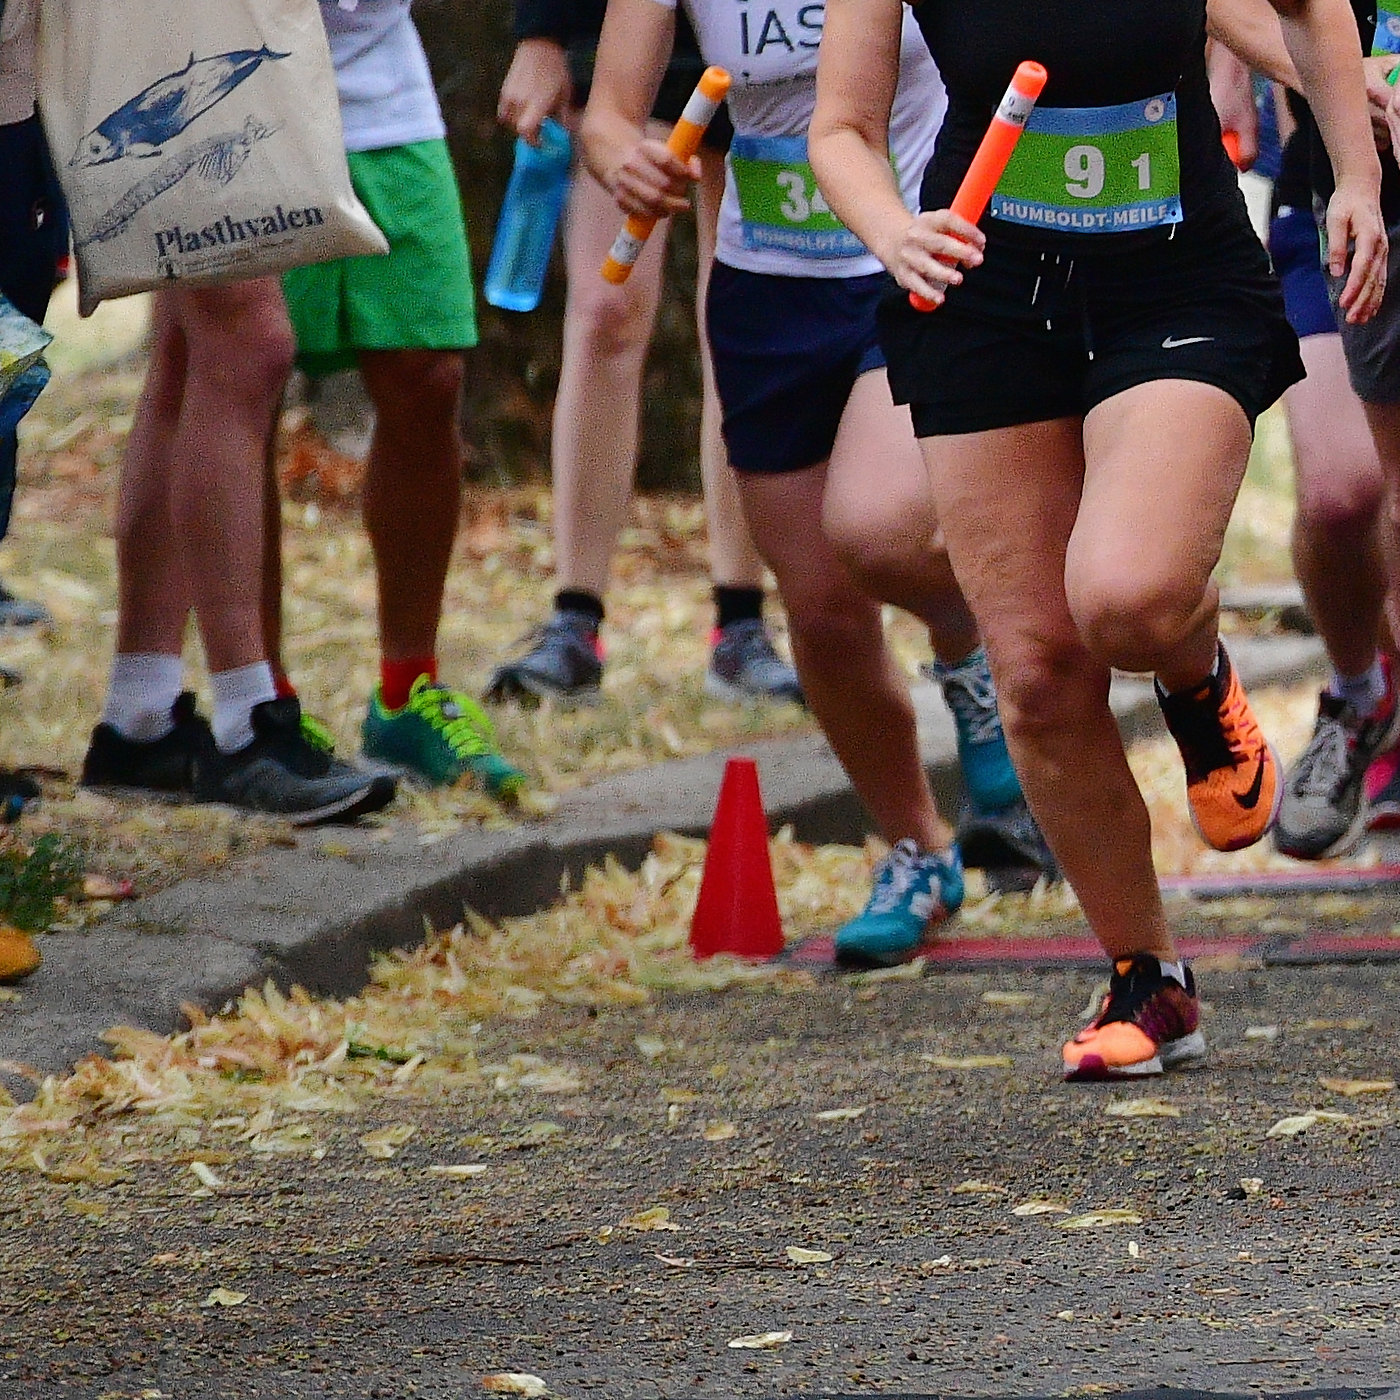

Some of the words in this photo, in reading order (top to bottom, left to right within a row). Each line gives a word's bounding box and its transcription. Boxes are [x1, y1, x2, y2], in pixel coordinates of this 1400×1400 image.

[1064, 145, 1105, 199] 9
[153, 203, 325, 258] Plasthvalen
[1002, 202, 1168, 228] HUMBOLDT-MEILE
